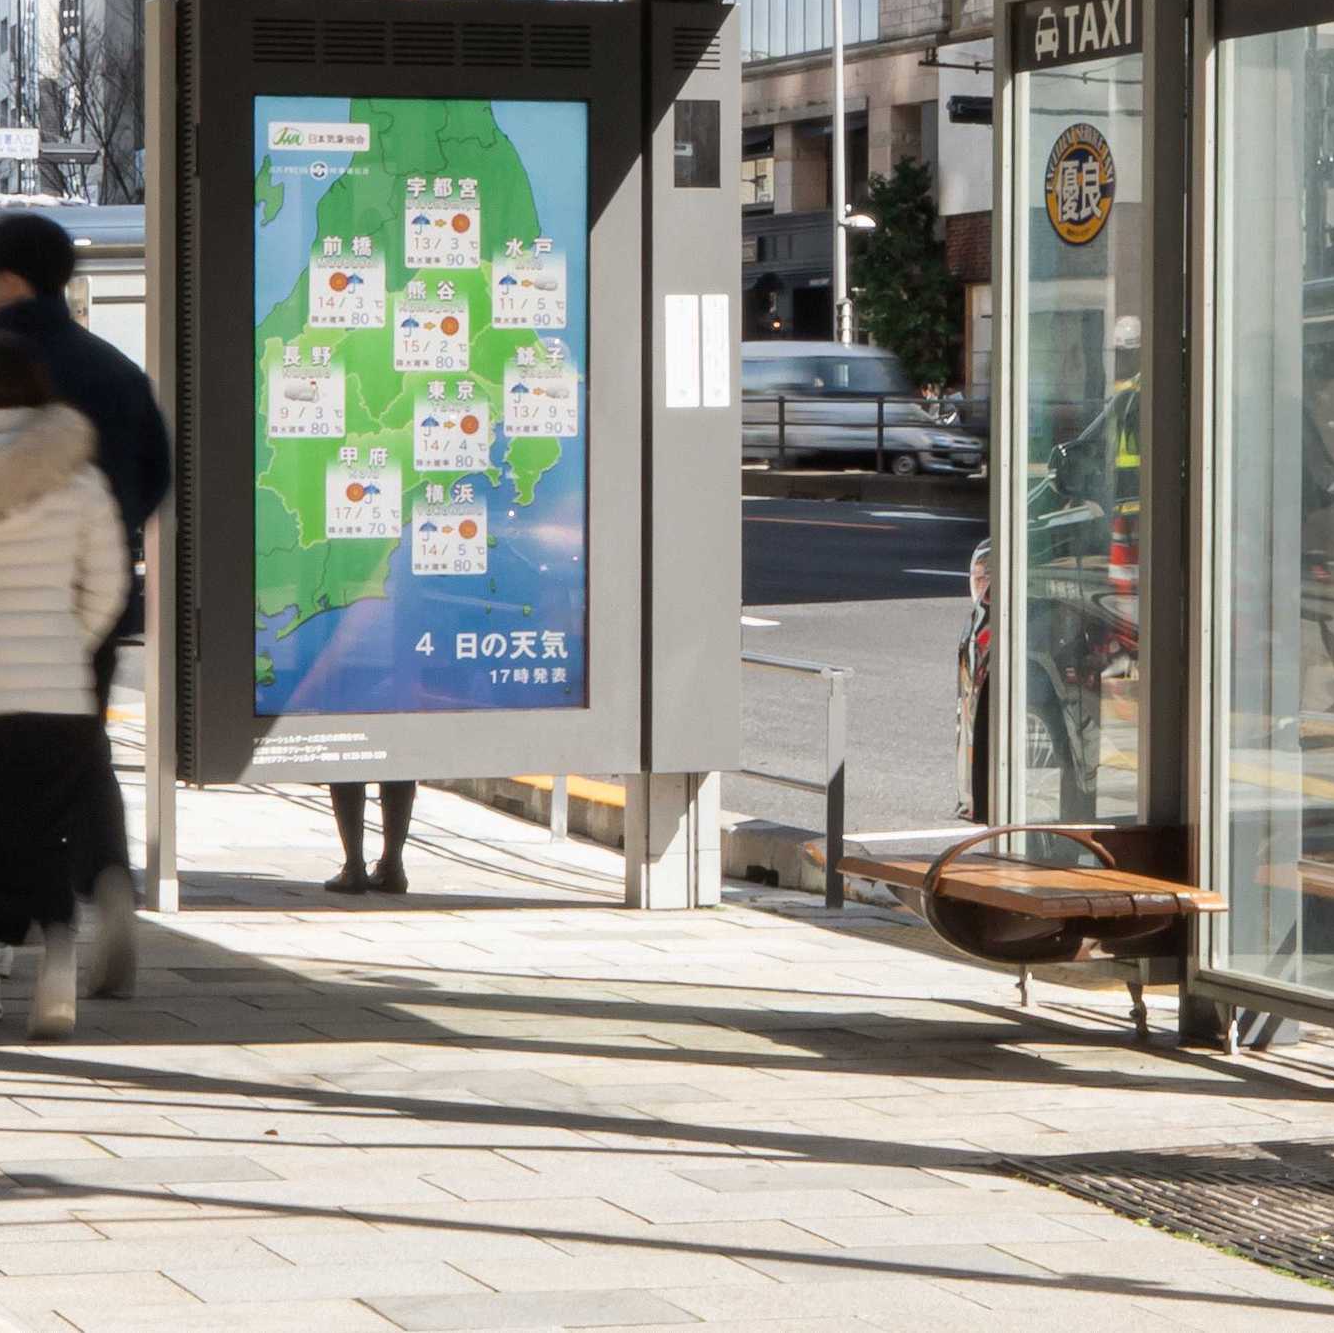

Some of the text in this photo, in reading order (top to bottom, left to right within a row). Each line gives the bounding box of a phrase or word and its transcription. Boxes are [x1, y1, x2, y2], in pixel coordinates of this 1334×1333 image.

[406, 177, 479, 200] 宇都宮
[1056, 156, 1102, 222] 優良
[322, 236, 373, 257] 前橋
[505, 237, 553, 258] 水戸
[446, 254, 465, 266] 90
[407, 280, 456, 301] 熊谷
[350, 313, 369, 325] 80
[533, 314, 551, 326] 90
[282, 346, 331, 367] 長野
[435, 356, 454, 369] 80
[427, 380, 476, 402] 東京
[310, 423, 329, 435] 80
[544, 422, 563, 434] 90
[339, 446, 389, 468] 甲府
[455, 455, 473, 468] 80
[426, 483, 474, 505] 横浜
[368, 523, 386, 535] 70
[453, 560, 472, 572] 80
[415, 630, 568, 660] 4 日の天気
[489, 668, 567, 684] 17時発表
